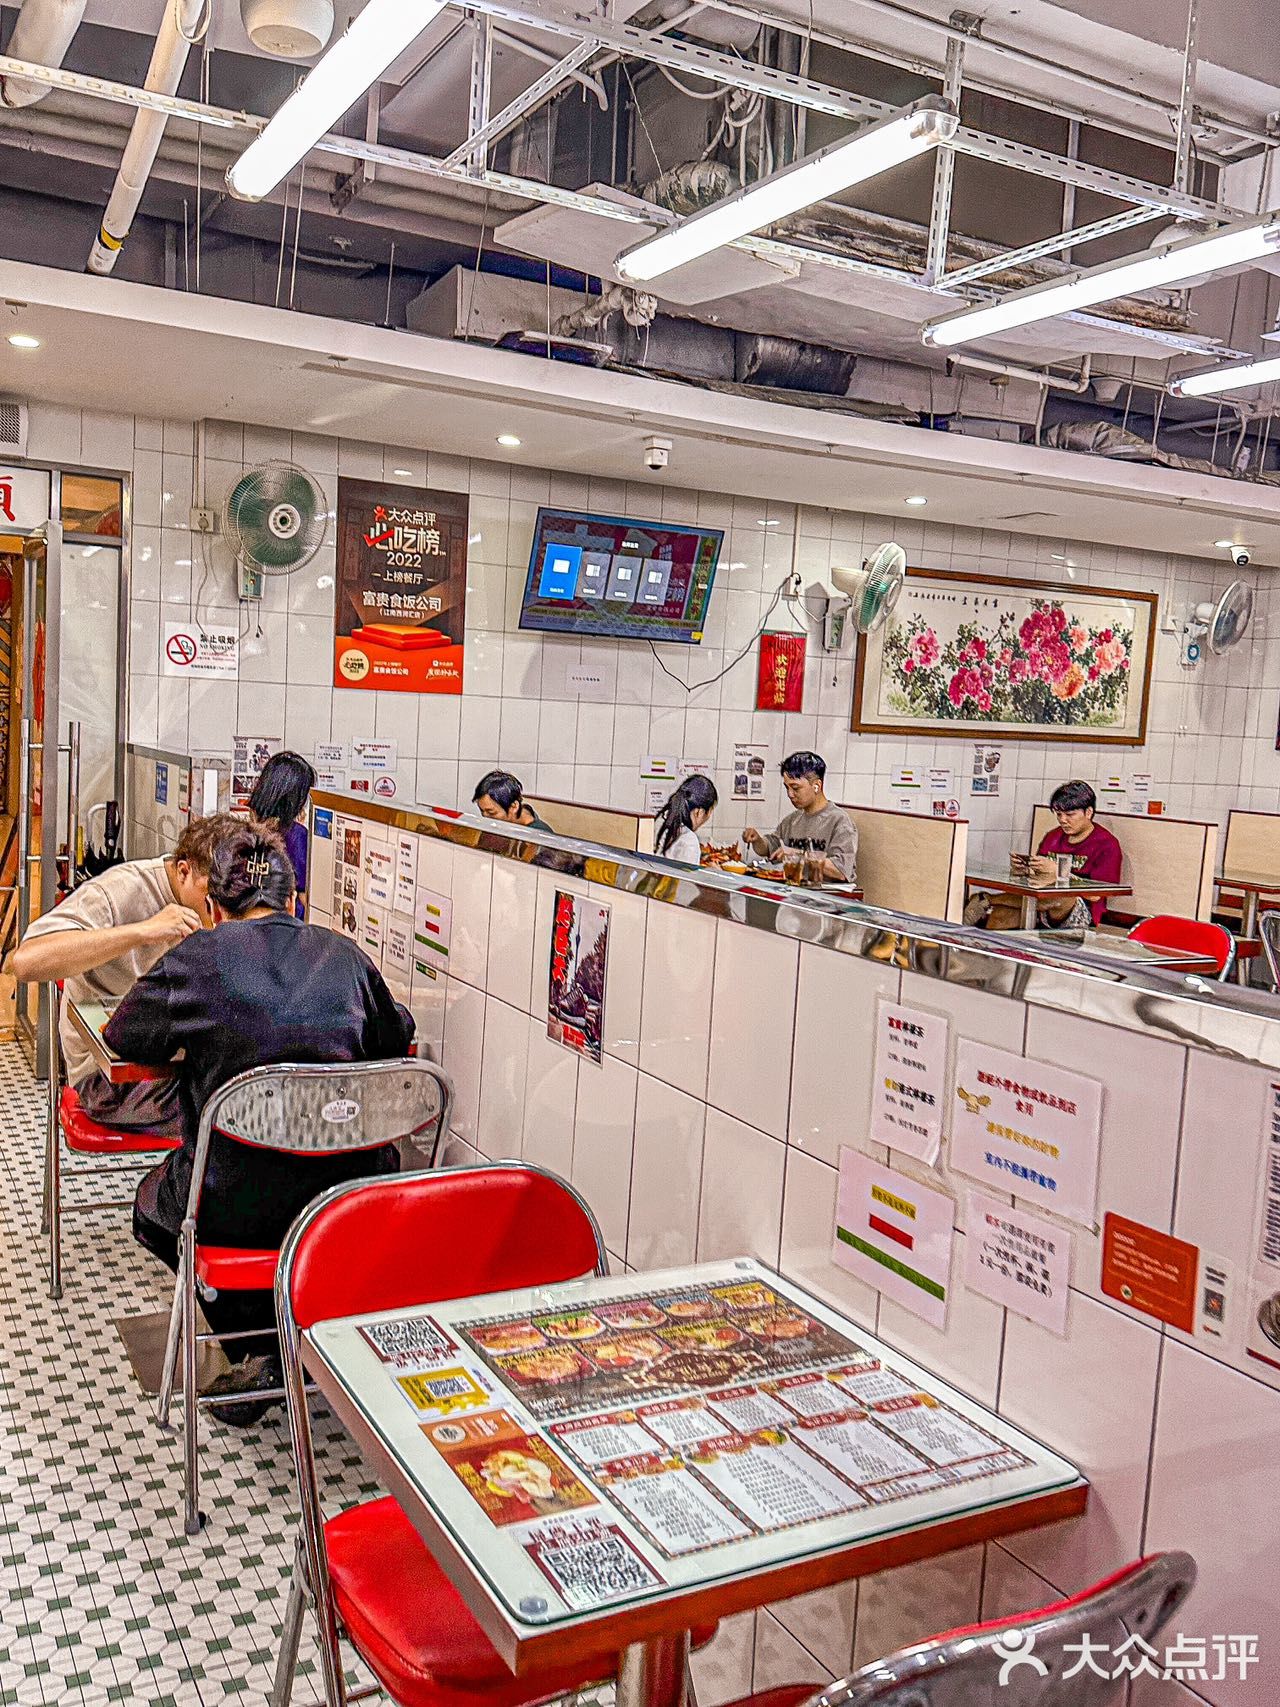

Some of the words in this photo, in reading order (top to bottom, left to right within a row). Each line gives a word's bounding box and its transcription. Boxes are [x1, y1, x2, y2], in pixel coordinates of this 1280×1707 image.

[388, 508, 436, 526] 大众点评
[364, 522, 440, 556] 必吃榜
[387, 552, 422, 568] 2022
[383, 570, 424, 585] 上榜餐厅
[363, 590, 442, 612] 富贵食饭公司
[200, 634, 236, 645] 禁止吸烟
